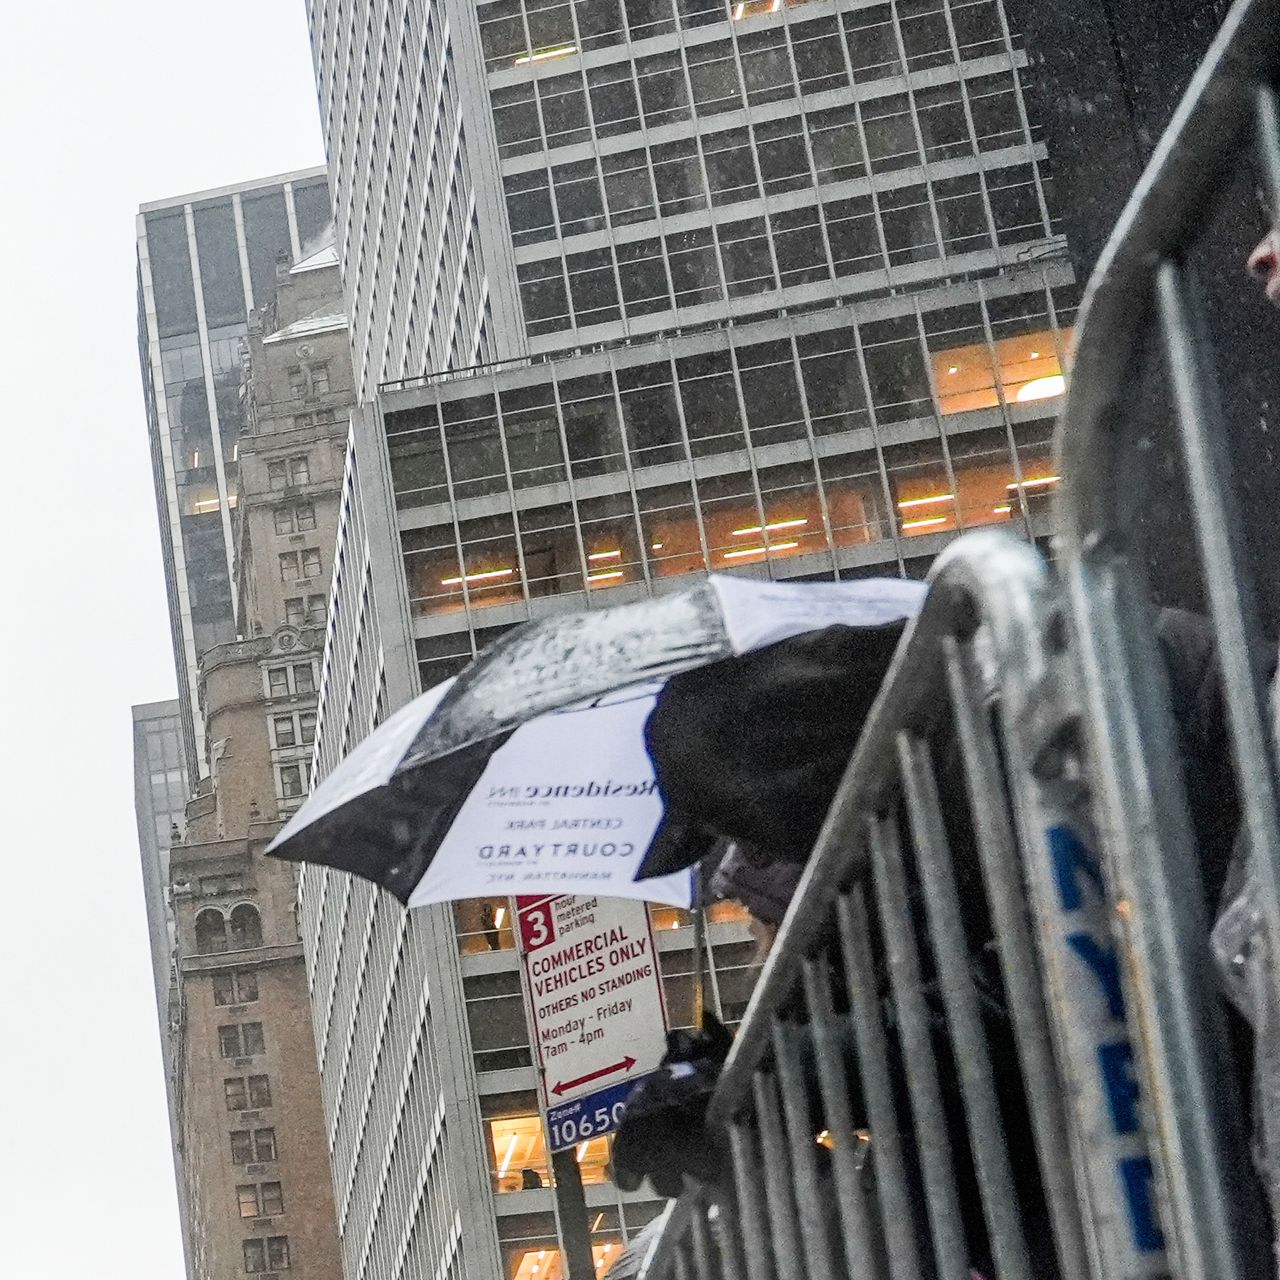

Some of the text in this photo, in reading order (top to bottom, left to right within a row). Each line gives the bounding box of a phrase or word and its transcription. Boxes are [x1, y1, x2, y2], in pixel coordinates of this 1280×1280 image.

[555, 895, 576, 911] hour
[556, 897, 598, 922] metered
[527, 911, 548, 946] 3
[558, 913, 595, 936] parking
[532, 926, 628, 977] COMMERCIAL
[535, 938, 647, 997] VEHICLES ONLY
[538, 964, 652, 1019] OTHERS NO STANDING
[542, 1017, 585, 1042] Monday
[596, 998, 633, 1021] Friday
[543, 1042, 568, 1059] 7am
[579, 1028, 605, 1045] 4pm
